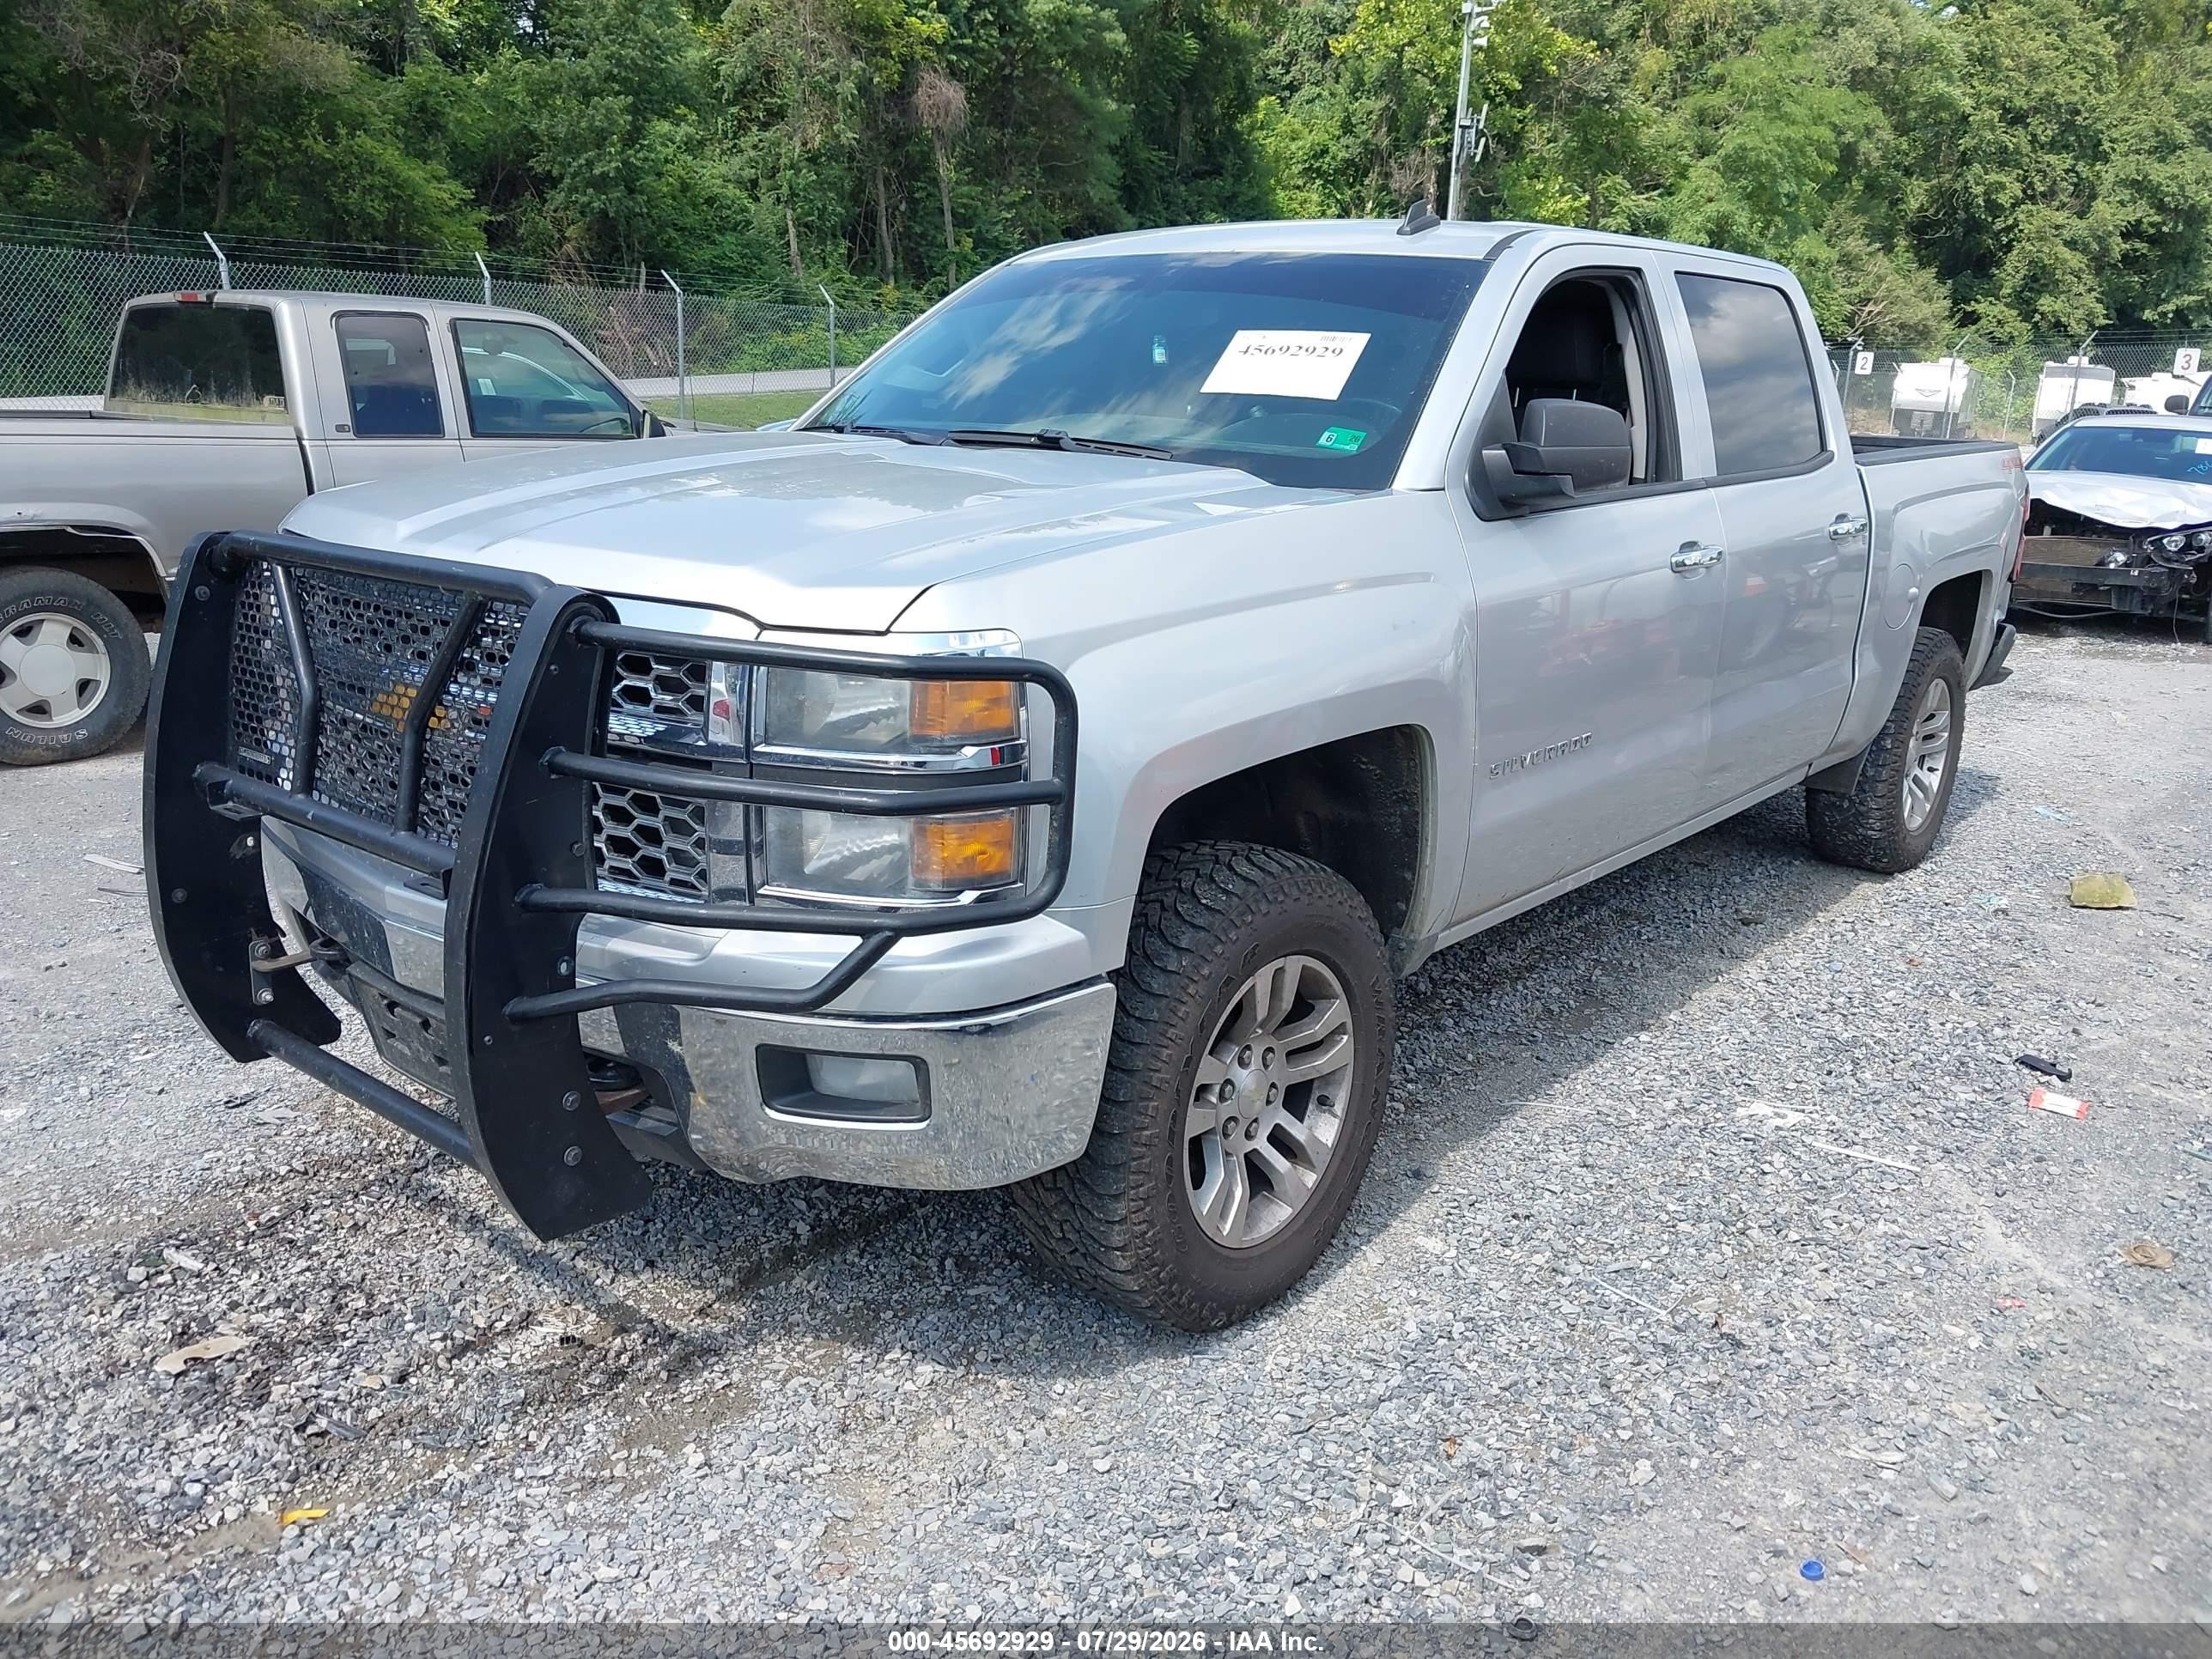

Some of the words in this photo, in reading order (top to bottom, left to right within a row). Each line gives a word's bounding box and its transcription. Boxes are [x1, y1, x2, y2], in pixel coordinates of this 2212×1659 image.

[1238, 344, 1344, 357] 45692929
[1860, 356, 1869, 370] 2
[2182, 354, 2192, 371] 3
[1325, 434, 1335, 443] 6
[5, 726, 88, 744] SAILUN
[1489, 732, 1593, 780] SILVERADO
